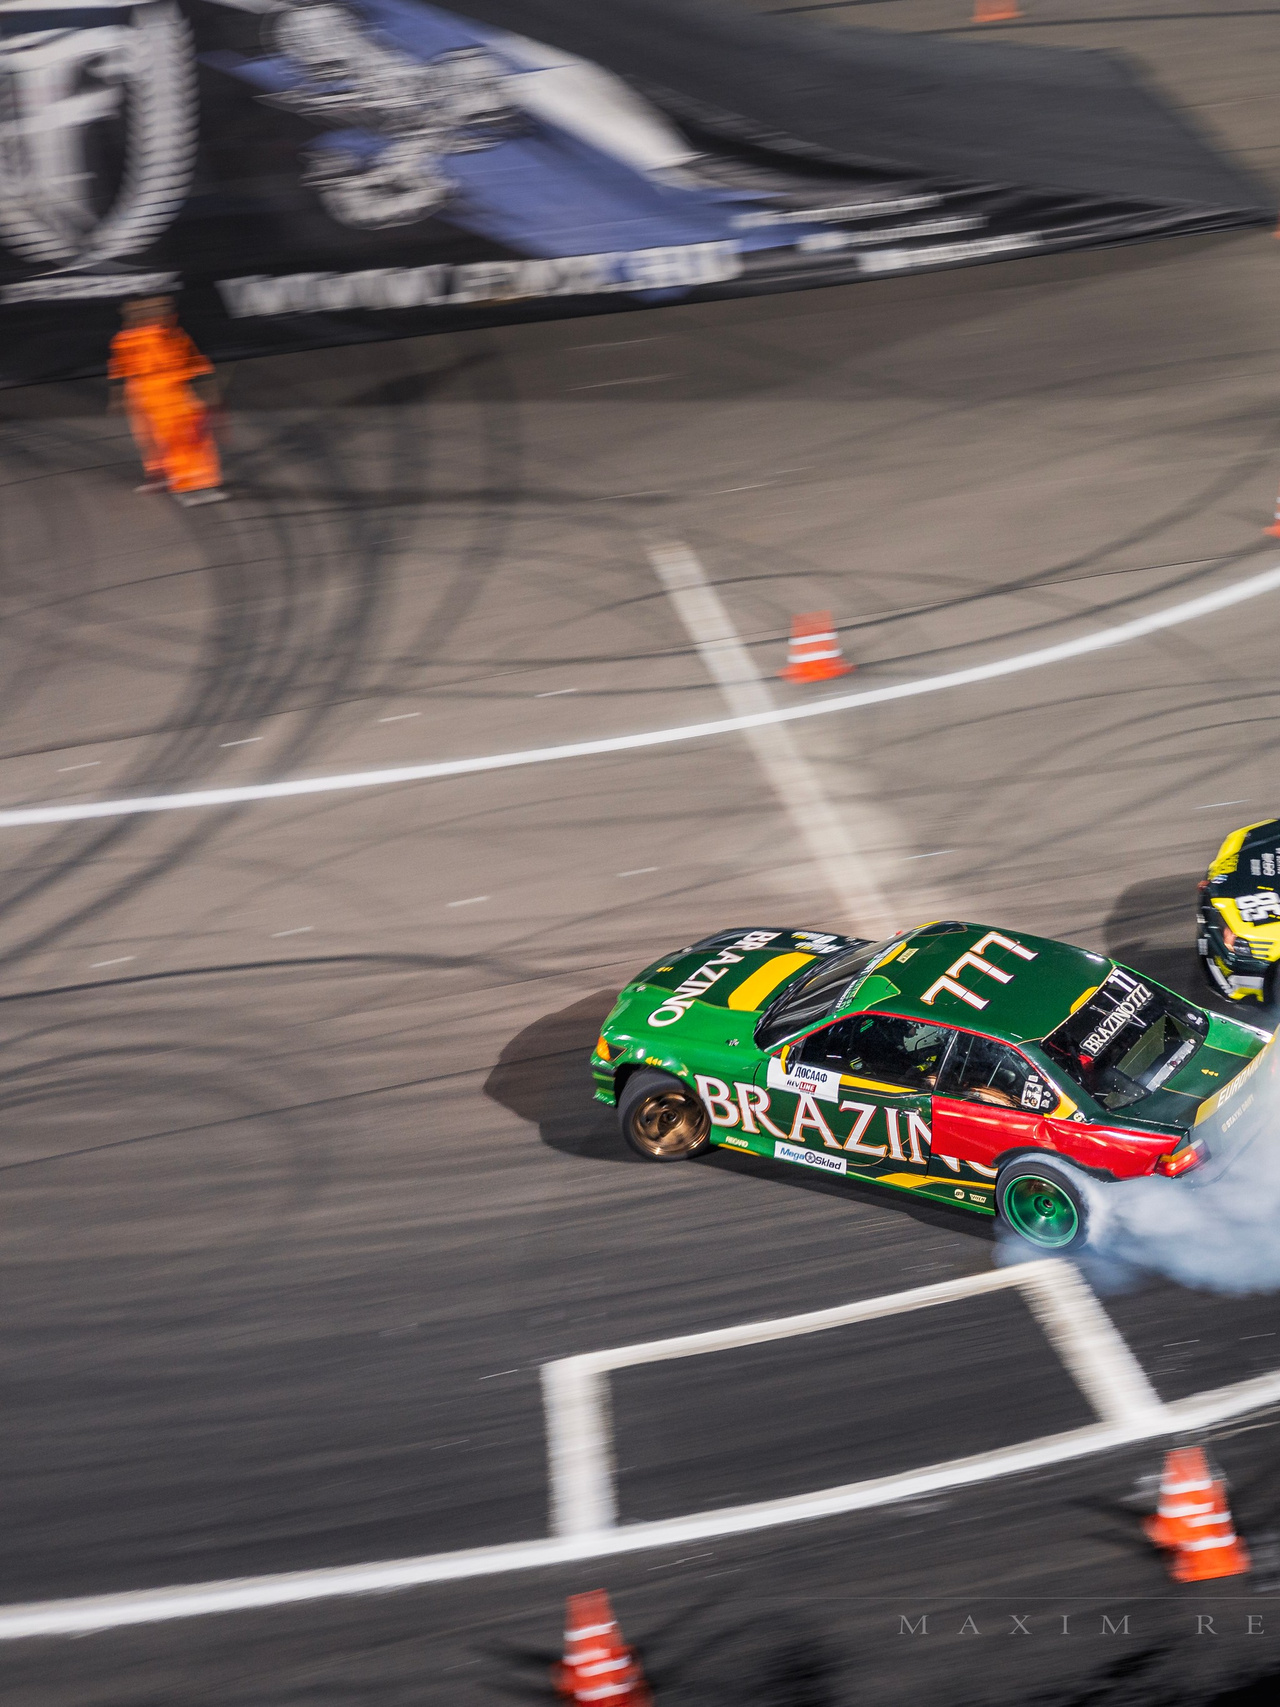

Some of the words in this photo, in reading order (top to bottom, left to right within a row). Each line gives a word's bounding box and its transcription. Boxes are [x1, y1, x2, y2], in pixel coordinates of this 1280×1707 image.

[647, 930, 783, 1028] BRAZINO
[920, 931, 1039, 1011] 777
[795, 1066, 828, 1083] ДОСААФ
[693, 1073, 998, 1178] BRAZIN
[780, 1147, 805, 1161] Mega
[814, 1156, 842, 1170] Sklad
